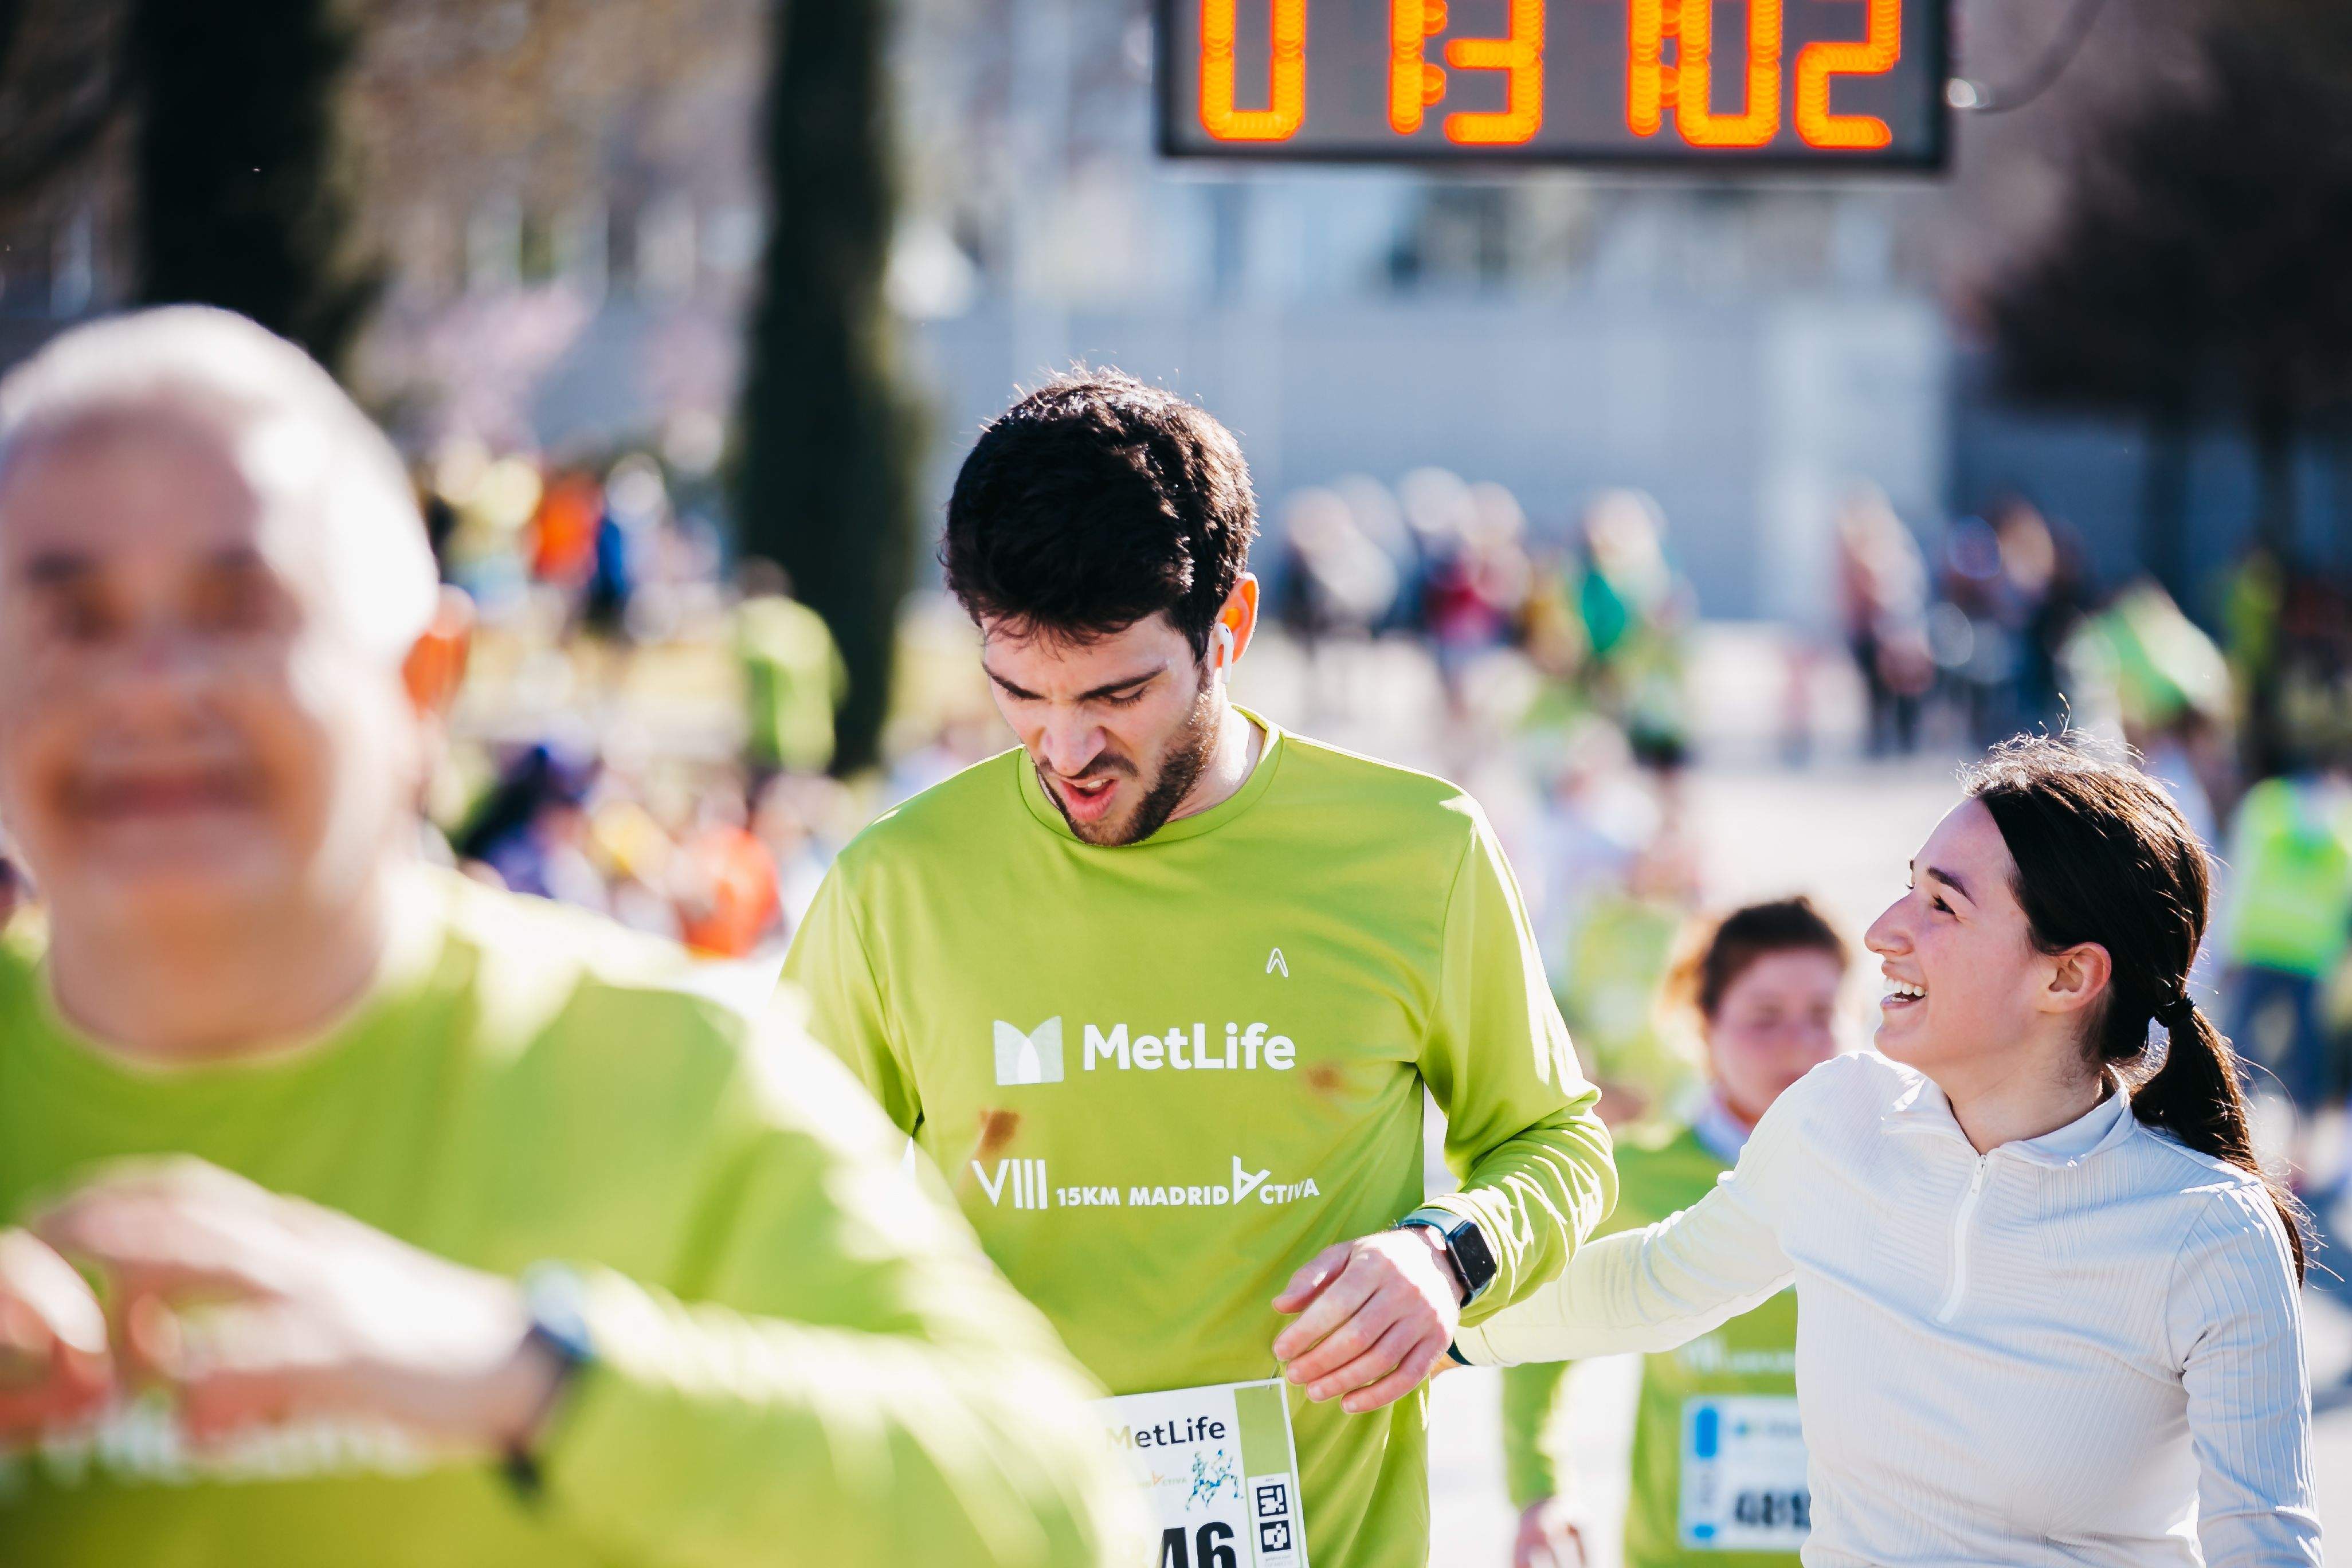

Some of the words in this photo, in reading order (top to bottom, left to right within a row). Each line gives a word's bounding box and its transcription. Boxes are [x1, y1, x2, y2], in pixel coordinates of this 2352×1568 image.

[1083, 1022, 1296, 1071] MetLife
[971, 1158, 1048, 1210] VIII
[1056, 1186, 1121, 1207] 15KM
[1138, 1521, 1237, 1568] 46
